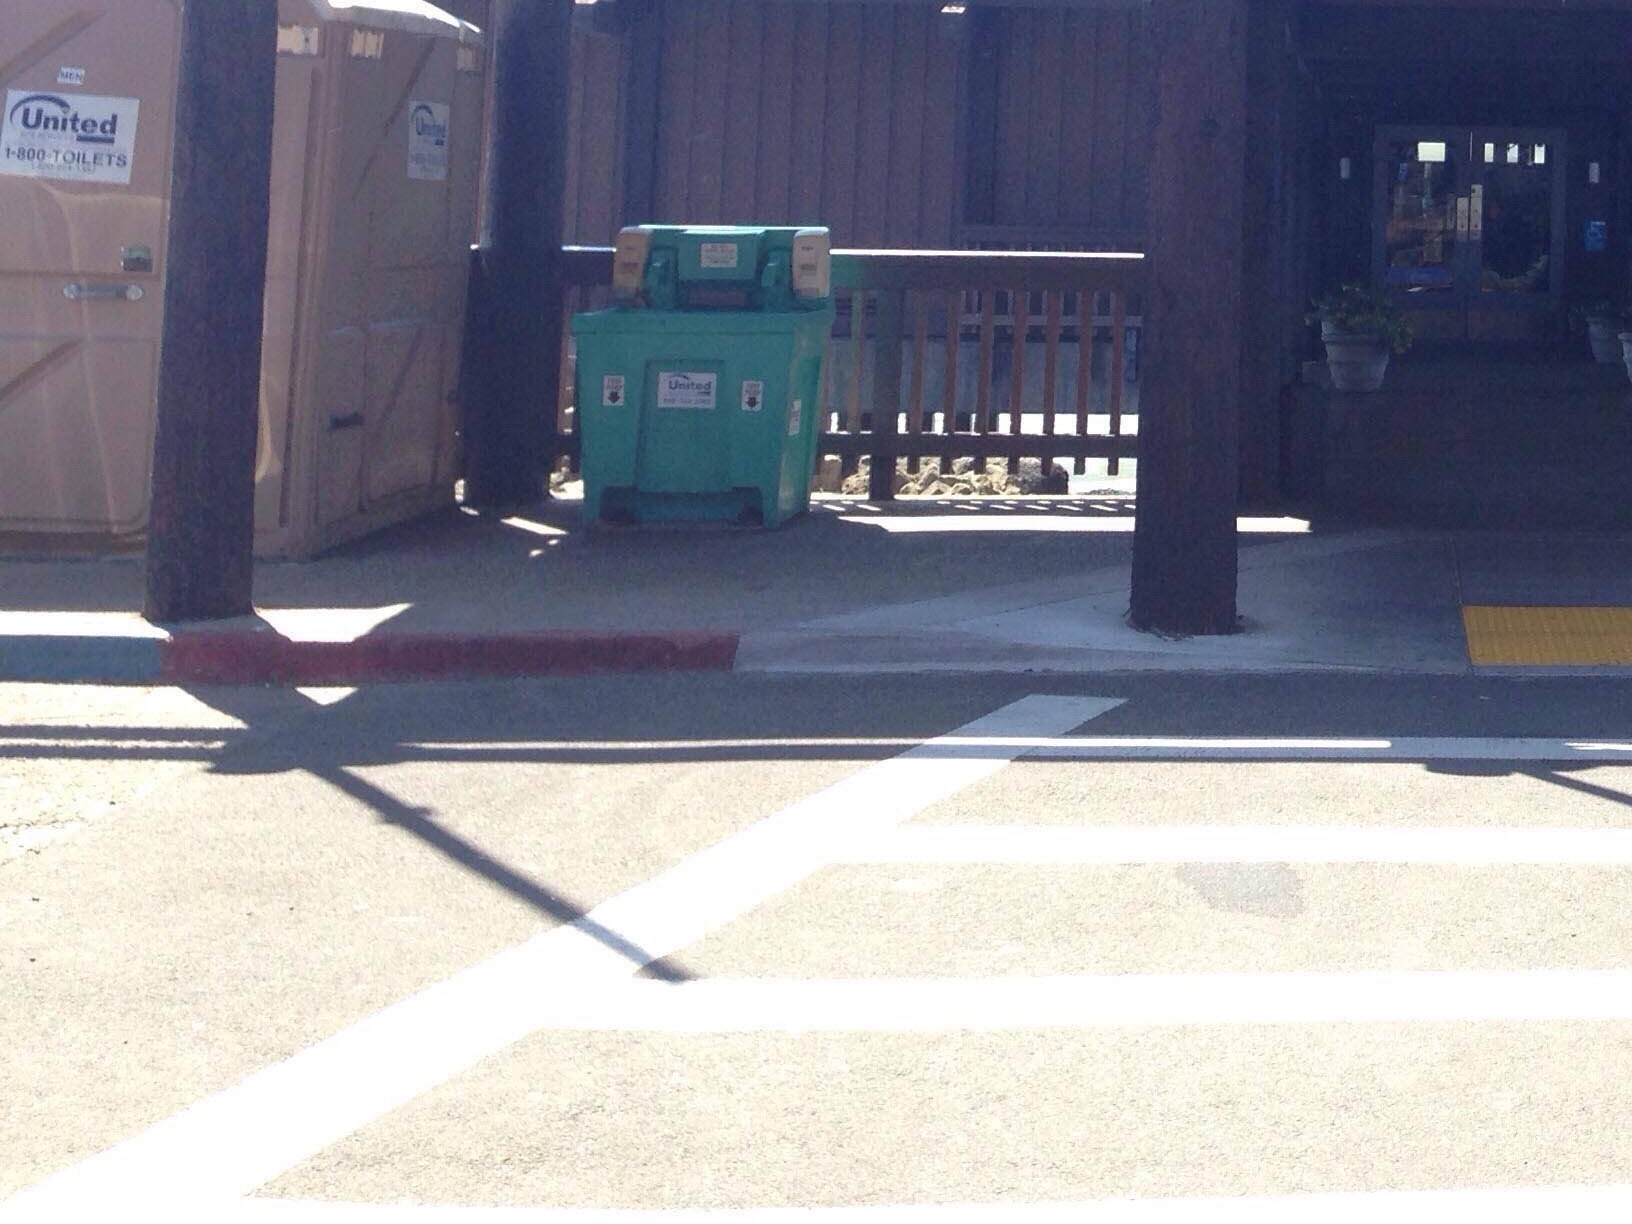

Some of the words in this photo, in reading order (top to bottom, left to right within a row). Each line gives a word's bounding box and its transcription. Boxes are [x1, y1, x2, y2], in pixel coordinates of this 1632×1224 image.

[21, 107, 118, 135] United
[5, 146, 128, 169] 1-800-TOILETS
[668, 380, 712, 390] United
